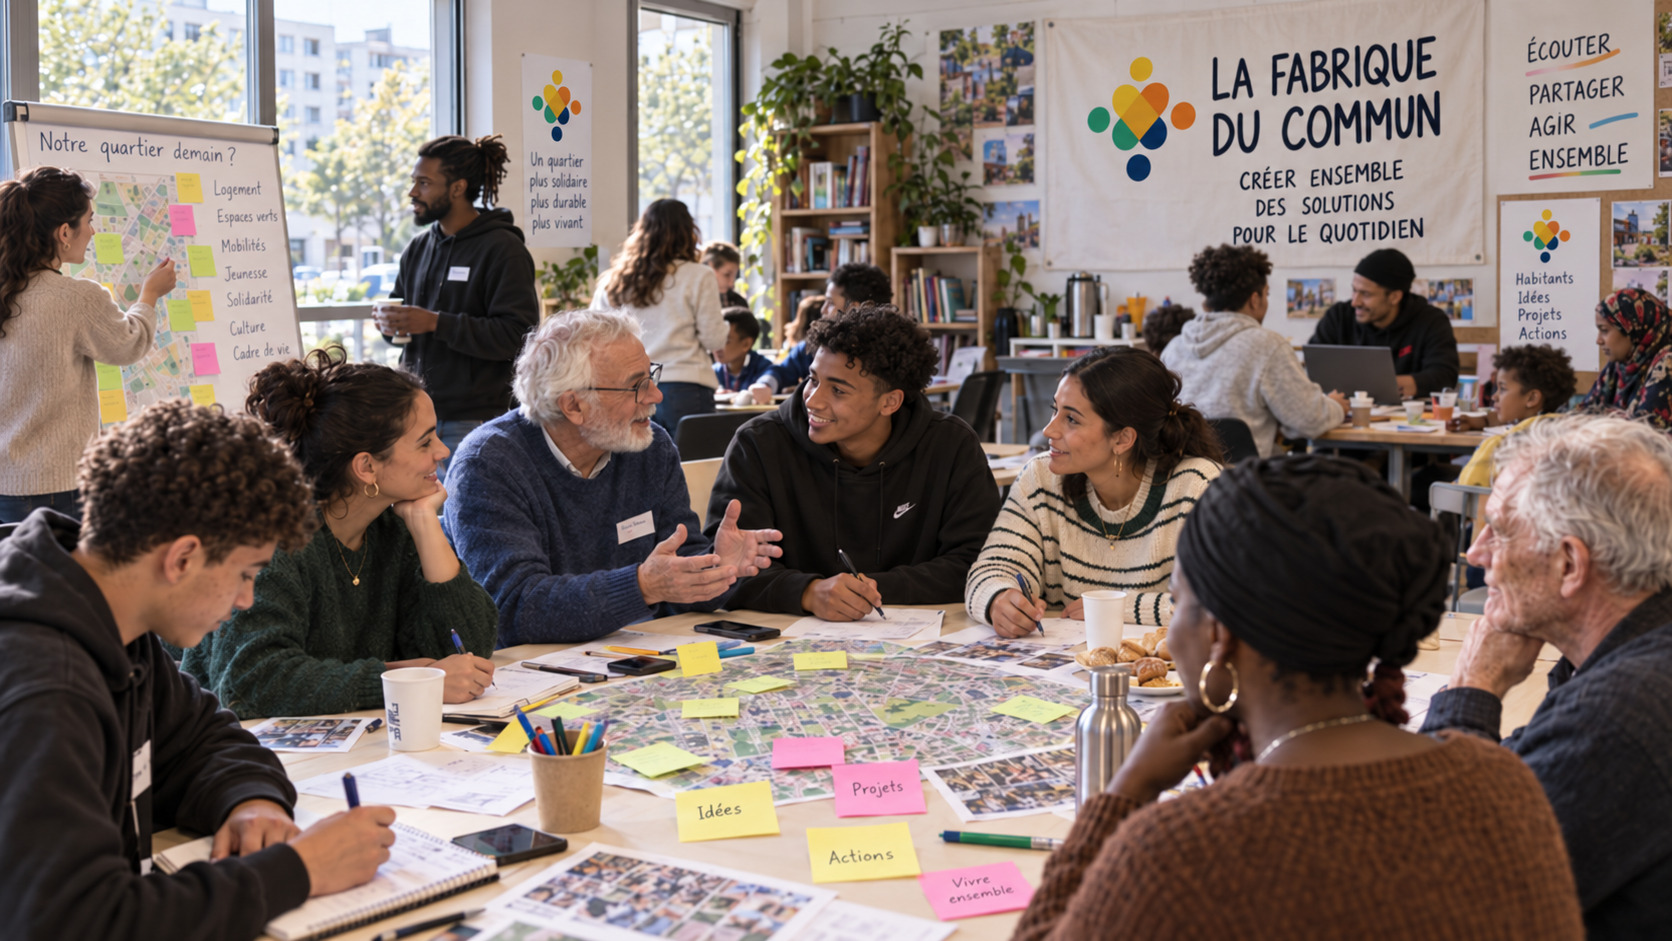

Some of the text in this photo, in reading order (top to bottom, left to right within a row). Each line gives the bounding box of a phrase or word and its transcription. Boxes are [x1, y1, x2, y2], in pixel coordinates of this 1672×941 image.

[1528, 33, 1611, 63] ÉCOUTER
[1212, 36, 1437, 101] LA FABRIQUE
[1530, 75, 1624, 105] PARTAGER
[1213, 90, 1440, 157] DU COMMUN
[40, 131, 236, 166] Notre quartier demain ?
[1530, 142, 1628, 171] ENSEMBLE
[531, 152, 584, 173] Un quartier
[530, 172, 587, 193] plus solidaire
[1240, 159, 1404, 191] CRÉER ENSEMBLE
[214, 180, 261, 201] Logement
[531, 193, 586, 214] plus durable
[1256, 191, 1394, 217] DES SOLUTIONS
[217, 208, 278, 227] Espaces verts
[532, 214, 583, 235] plus vivant
[1233, 217, 1424, 246] POUR LE QUOTIDIEN
[221, 237, 266, 253] Mobilités
[224, 266, 268, 282] Jeunesse
[1516, 271, 1574, 285] Habitants
[227, 289, 273, 307] Solidarité
[1518, 290, 1550, 304] Idées
[1518, 307, 1562, 325] Projets
[230, 321, 266, 336] Culture
[1519, 326, 1567, 340] Actions
[233, 342, 290, 361] Cadre de vie
[852, 780, 903, 798] Projets
[698, 803, 742, 820] Idées
[829, 849, 894, 865] Actions
[952, 875, 991, 889] Vivre
[949, 885, 1014, 904] ensemble
